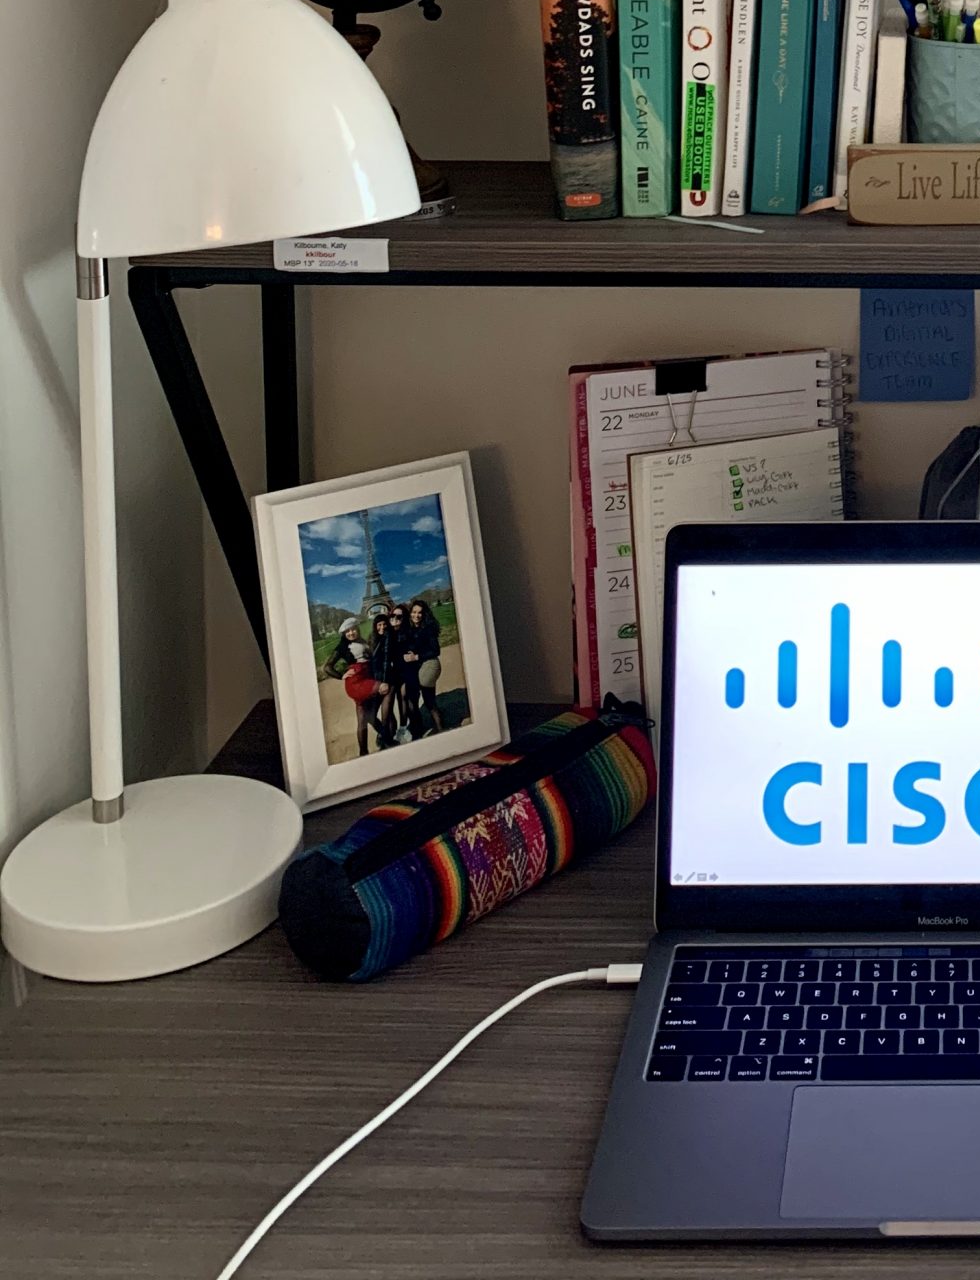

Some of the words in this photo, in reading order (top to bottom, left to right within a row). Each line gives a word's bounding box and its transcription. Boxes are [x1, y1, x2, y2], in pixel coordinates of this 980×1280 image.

[780, 13, 789, 37] LINE
[855, 15, 868, 40] JOY
[779, 38, 787, 46] A
[778, 48, 787, 70] DAY
[581, 65, 596, 111] SING
[635, 94, 649, 151] CAINE
[695, 96, 706, 132] USED
[850, 105, 859, 124] KAY
[693, 136, 704, 175] BOOK
[703, 134, 713, 184] OUTFITTERS
[896, 161, 942, 201] Live
[294, 241, 328, 250] Kilbourne,
[330, 242, 347, 250] Katy
[303, 259, 315, 267] 13"
[600, 383, 648, 401] JUNE
[601, 415, 623, 432] 22
[628, 410, 660, 420] MONDAY
[581, 447, 589, 468] MAR
[666, 453, 693, 466] 6/25
[604, 494, 627, 512] 23
[608, 575, 631, 593] 24
[612, 656, 634, 675] 25
[592, 680, 600, 701] NOV
[918, 916, 954, 925] MacBook
[956, 916, 969, 925] Pro
